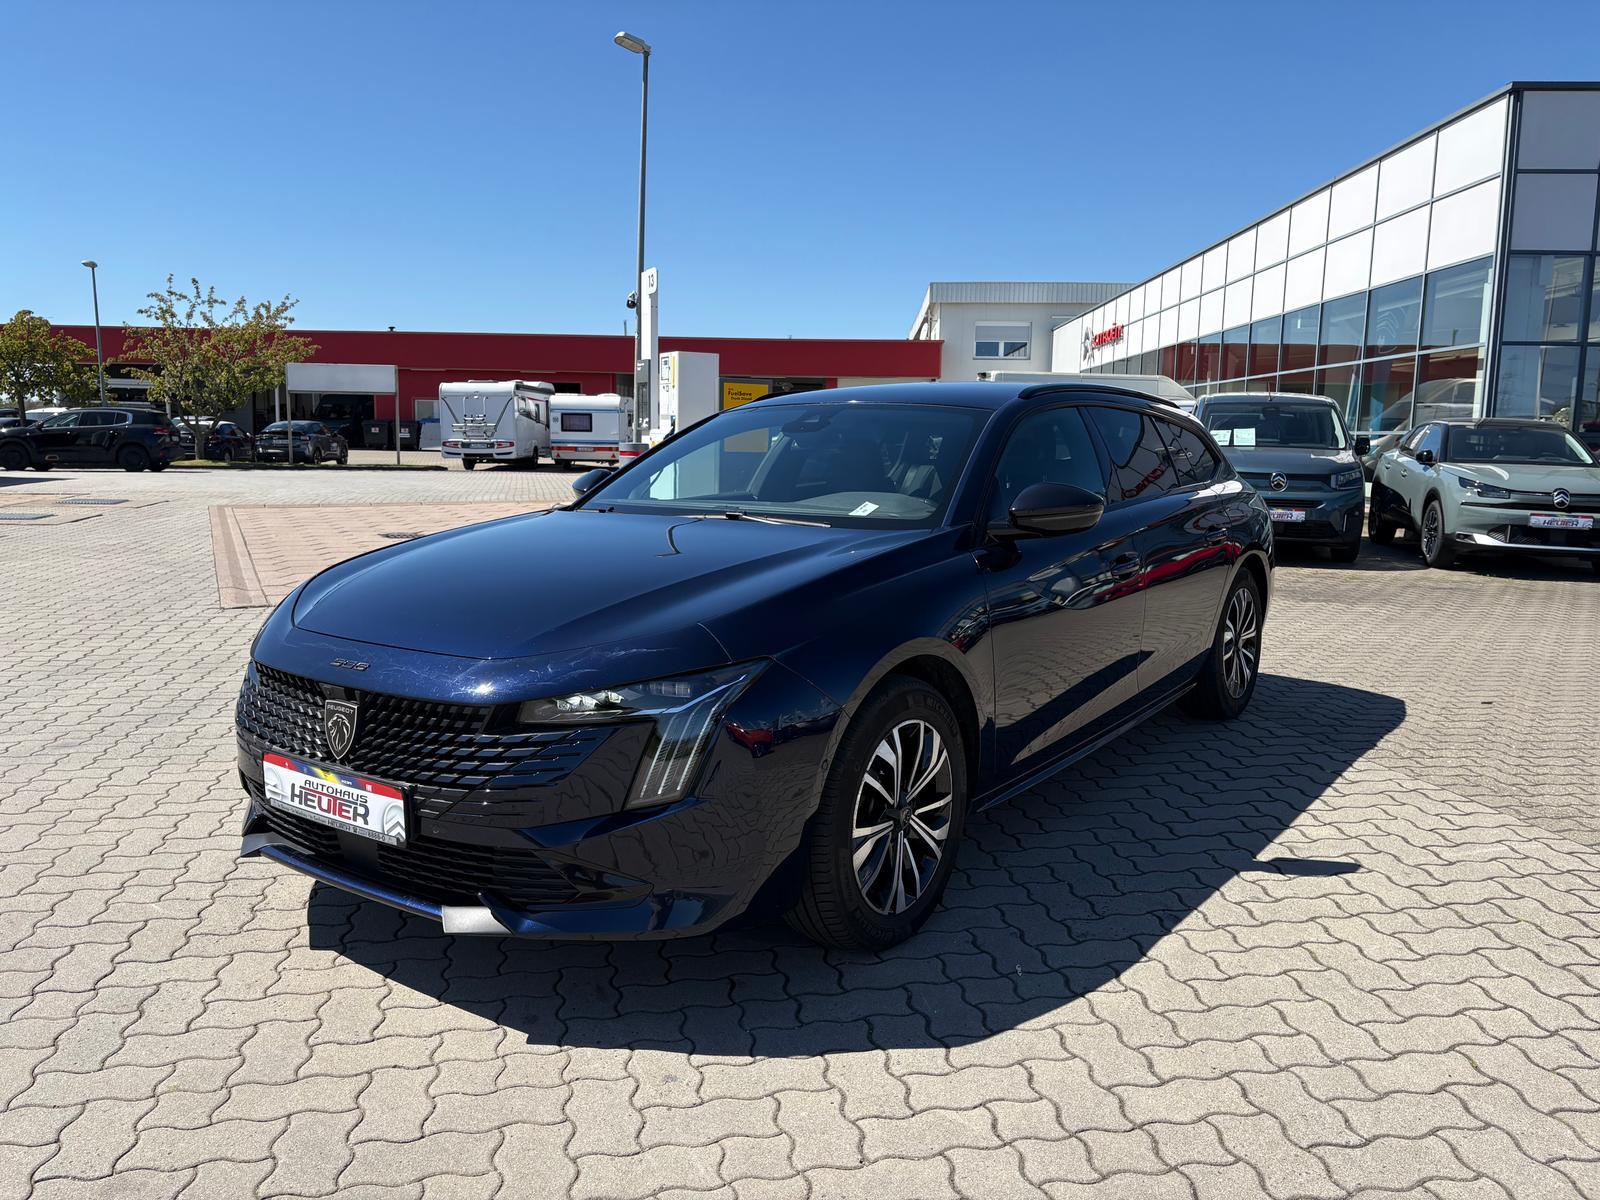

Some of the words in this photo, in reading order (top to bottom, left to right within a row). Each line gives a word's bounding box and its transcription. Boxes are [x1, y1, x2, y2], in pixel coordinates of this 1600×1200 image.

[647, 274, 655, 288] 13
[326, 704, 355, 715] PEUGEOT
[303, 778, 369, 805] AUTOHAUS
[289, 782, 371, 827] HEUTER
